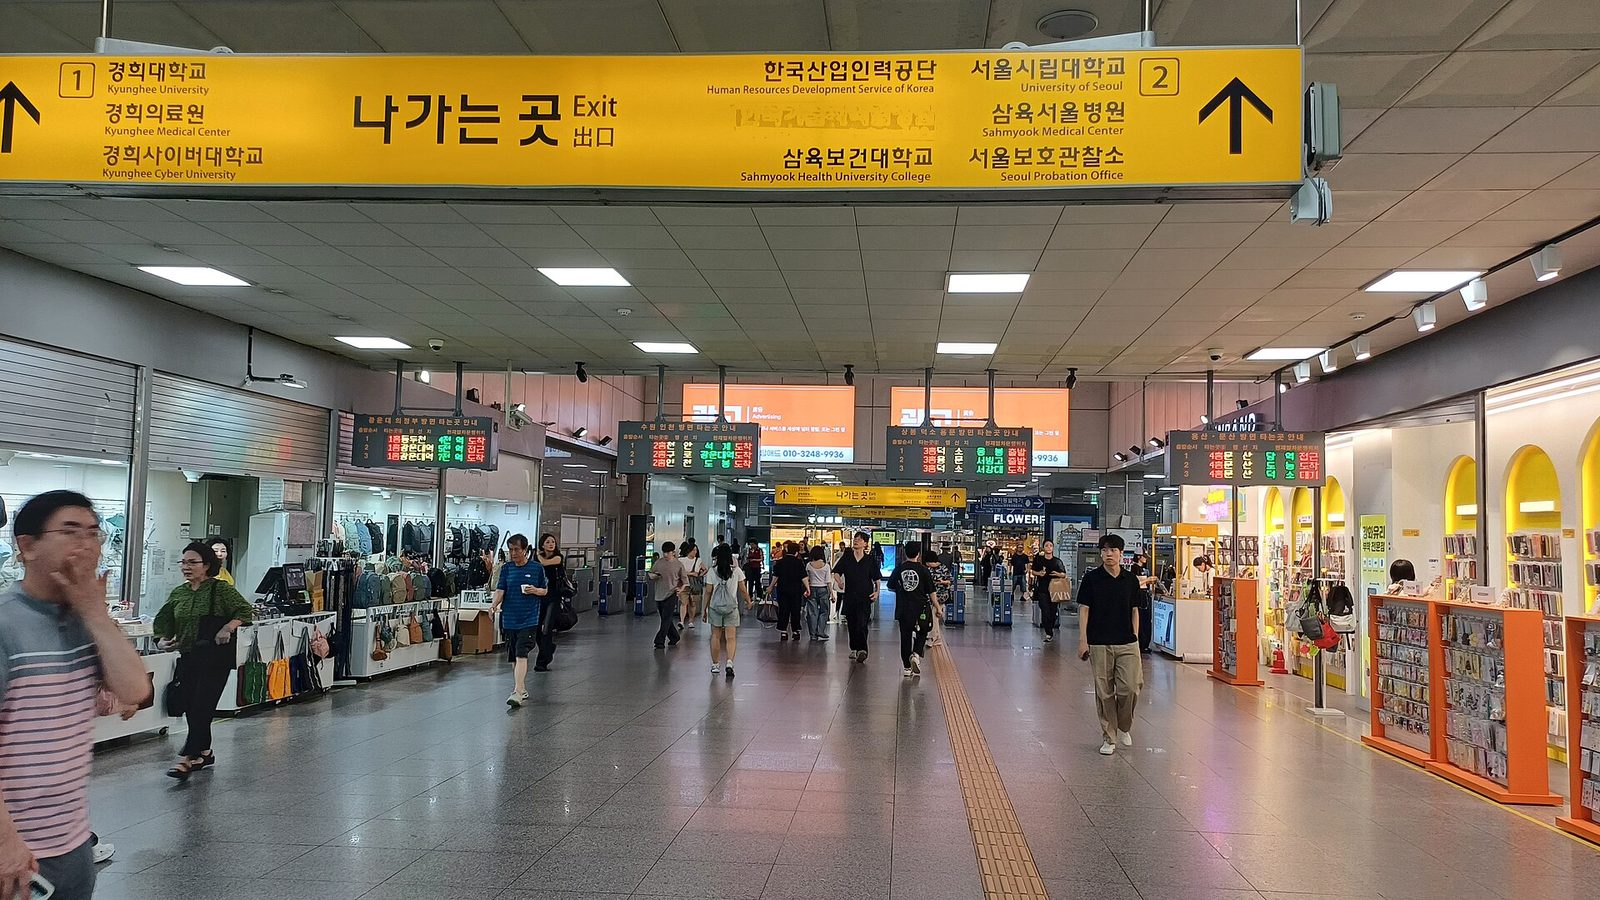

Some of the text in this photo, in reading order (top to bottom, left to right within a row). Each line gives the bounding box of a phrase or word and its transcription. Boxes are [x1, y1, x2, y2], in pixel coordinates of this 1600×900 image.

[108, 61, 207, 83] 경희대학교
[765, 60, 937, 82] 한국산업인력공단
[970, 57, 1126, 81] 서울시립대학교
[72, 69, 80, 91] 1
[1152, 66, 1169, 89] 2
[107, 84, 210, 96] Kyunghee University
[707, 84, 935, 96] Human Resources Development Service of Korea
[1021, 81, 1123, 94] University of Seoul
[573, 94, 617, 117] Exit
[105, 103, 205, 125] 경희의료원
[992, 101, 1125, 124] 삼육서울병원
[353, 94, 561, 147] 나가는 곳
[104, 126, 231, 138] Kyunghee Medical Center
[573, 126, 615, 148] 出口
[982, 126, 1124, 140] Sahmyook Medical Center
[102, 145, 263, 168] 경희사이버대학교
[783, 147, 933, 169] 삼육보건대학교
[969, 146, 1124, 169] 서울보호관찰소
[102, 168, 236, 181] Kyunghee Cyber University
[740, 172, 931, 184] Sahmyook Health University College
[1000, 170, 1124, 182] Seoul Probation Office
[395, 417, 418, 425] 의정부
[1003, 429, 1019, 437] 안내
[1240, 433, 1257, 441] 방면
[1288, 433, 1304, 441] 안내
[467, 436, 486, 445] 도착
[735, 442, 753, 451] 도착
[466, 453, 485, 462] 도착
[700, 450, 735, 459] 광운대역
[735, 451, 752, 460] 도착
[782, 449, 844, 458] 010-3248-9936
[1299, 452, 1318, 461] 접근
[734, 460, 752, 469] 도착
[976, 456, 1004, 465] 서빙고
[1300, 462, 1319, 470] 도착
[976, 465, 1004, 474] 서강대
[1007, 465, 1026, 474] 도착
[1300, 471, 1319, 480] 대기
[836, 491, 868, 500] 나가는 곳
